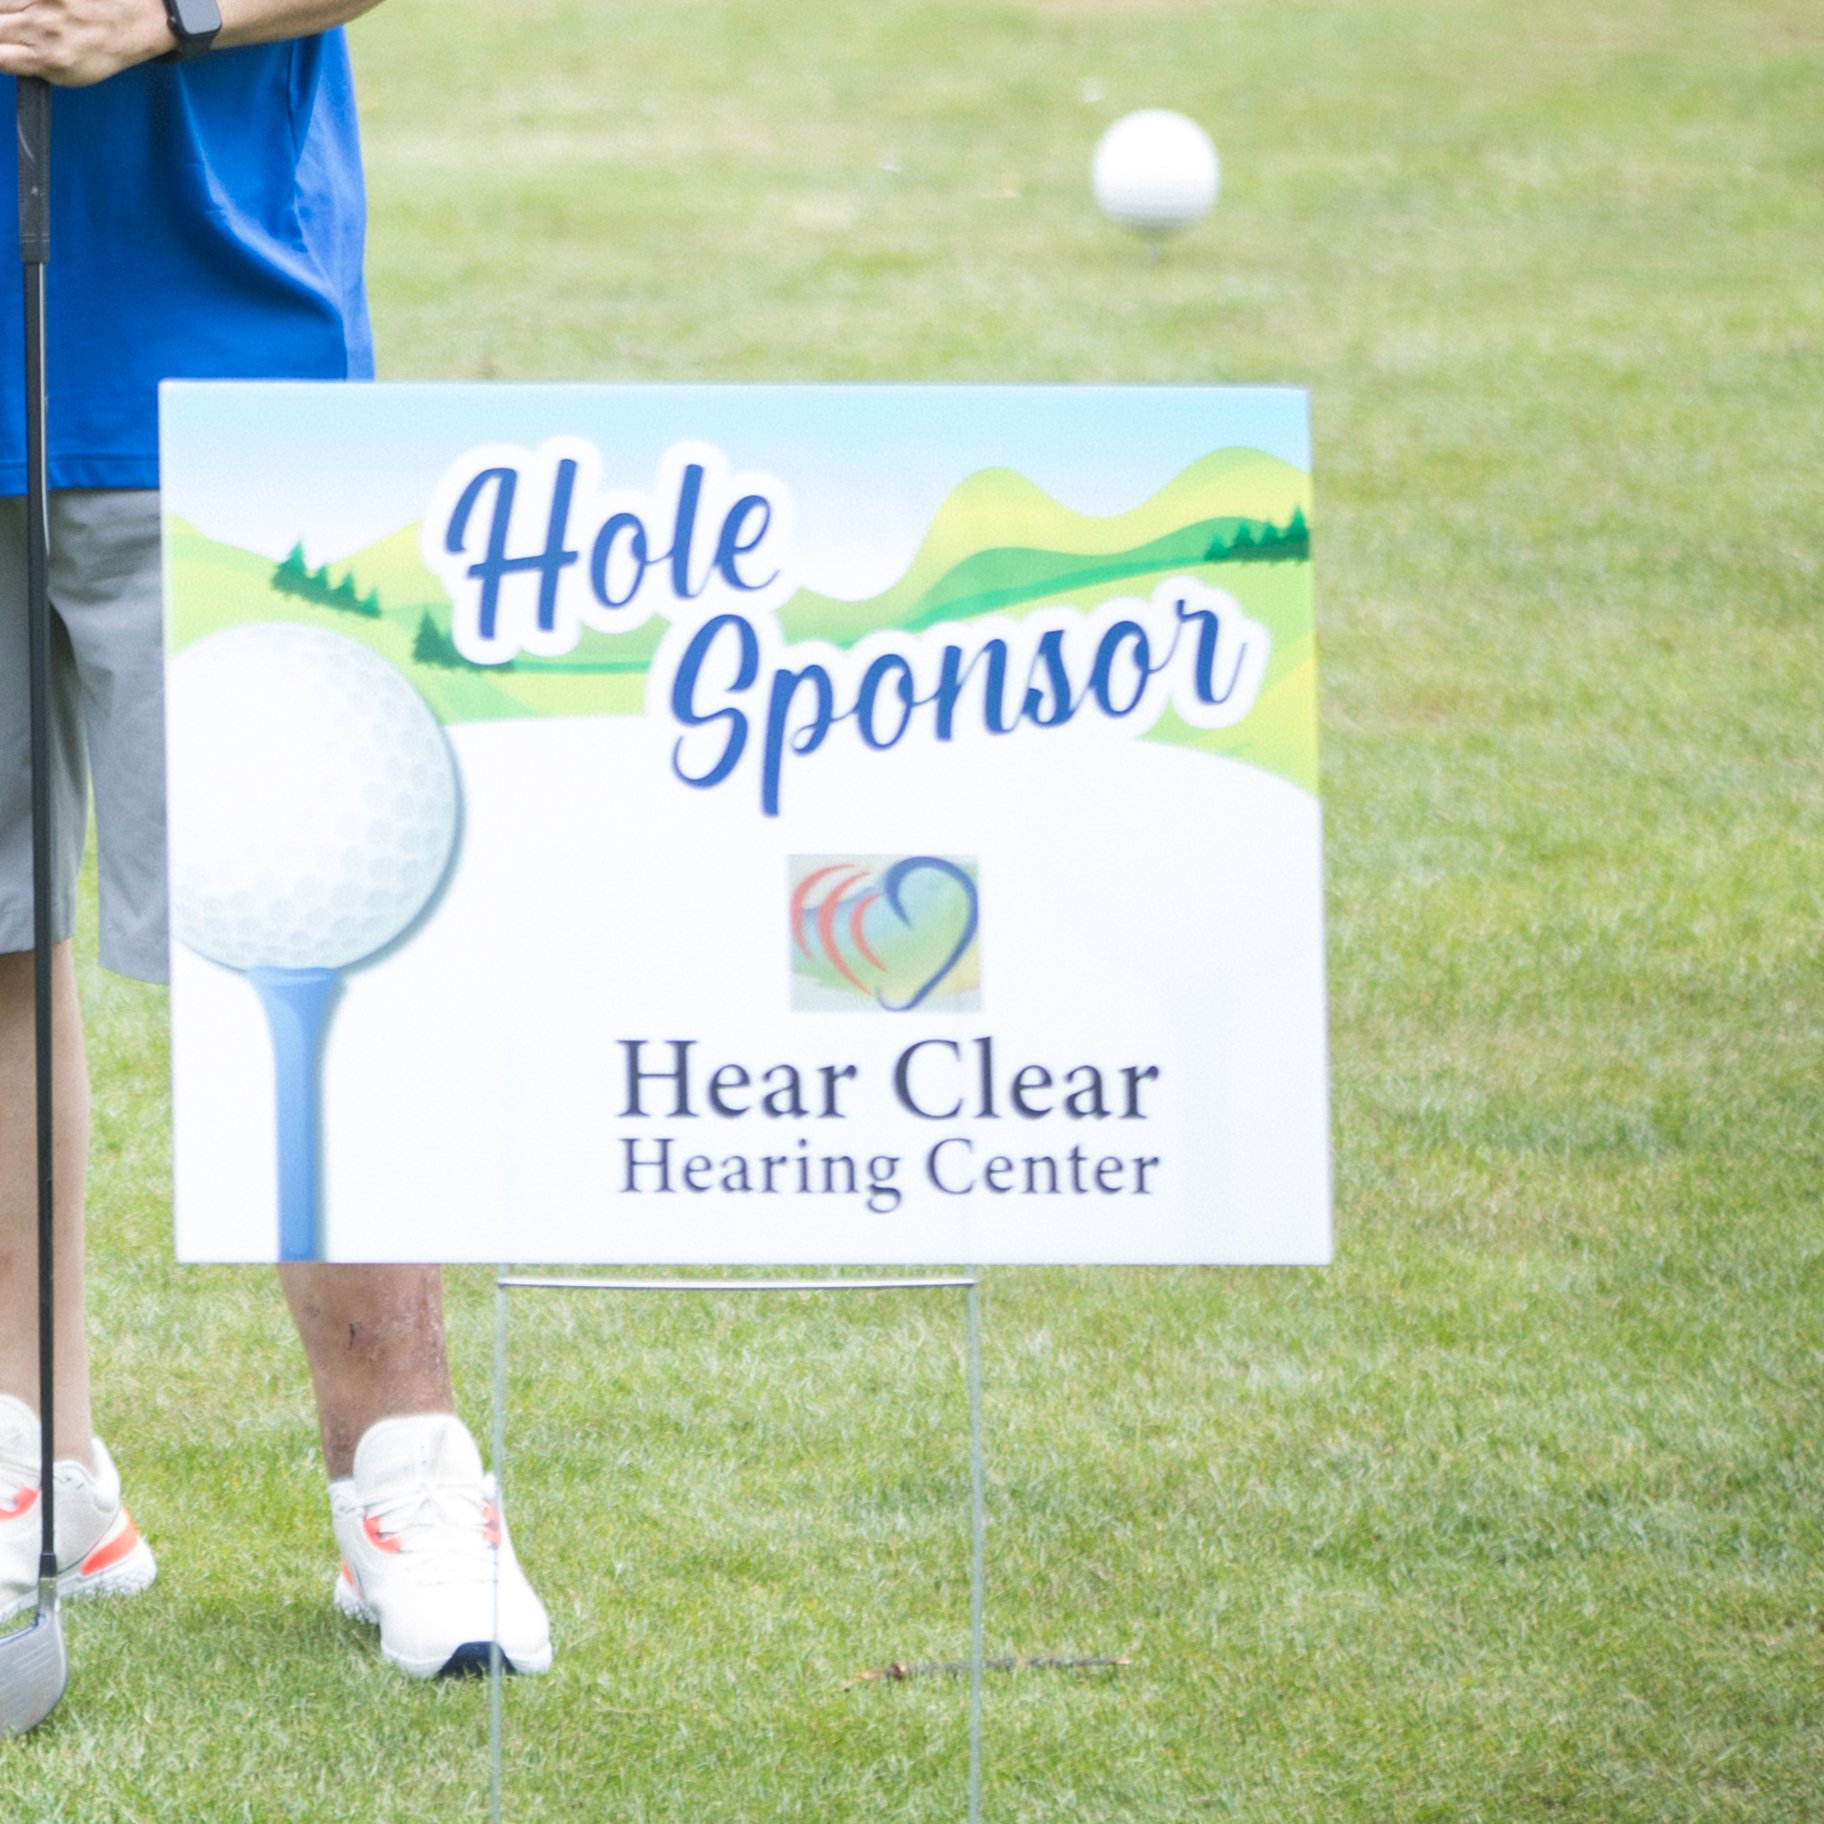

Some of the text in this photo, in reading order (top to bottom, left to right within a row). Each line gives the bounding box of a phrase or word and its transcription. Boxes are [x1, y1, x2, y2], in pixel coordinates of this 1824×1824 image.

[445, 458, 781, 640] Hole
[671, 598, 1247, 817] Sponsor
[617, 1035, 1161, 1120] Hear Clear
[620, 1137, 1161, 1214] Hearing Center
